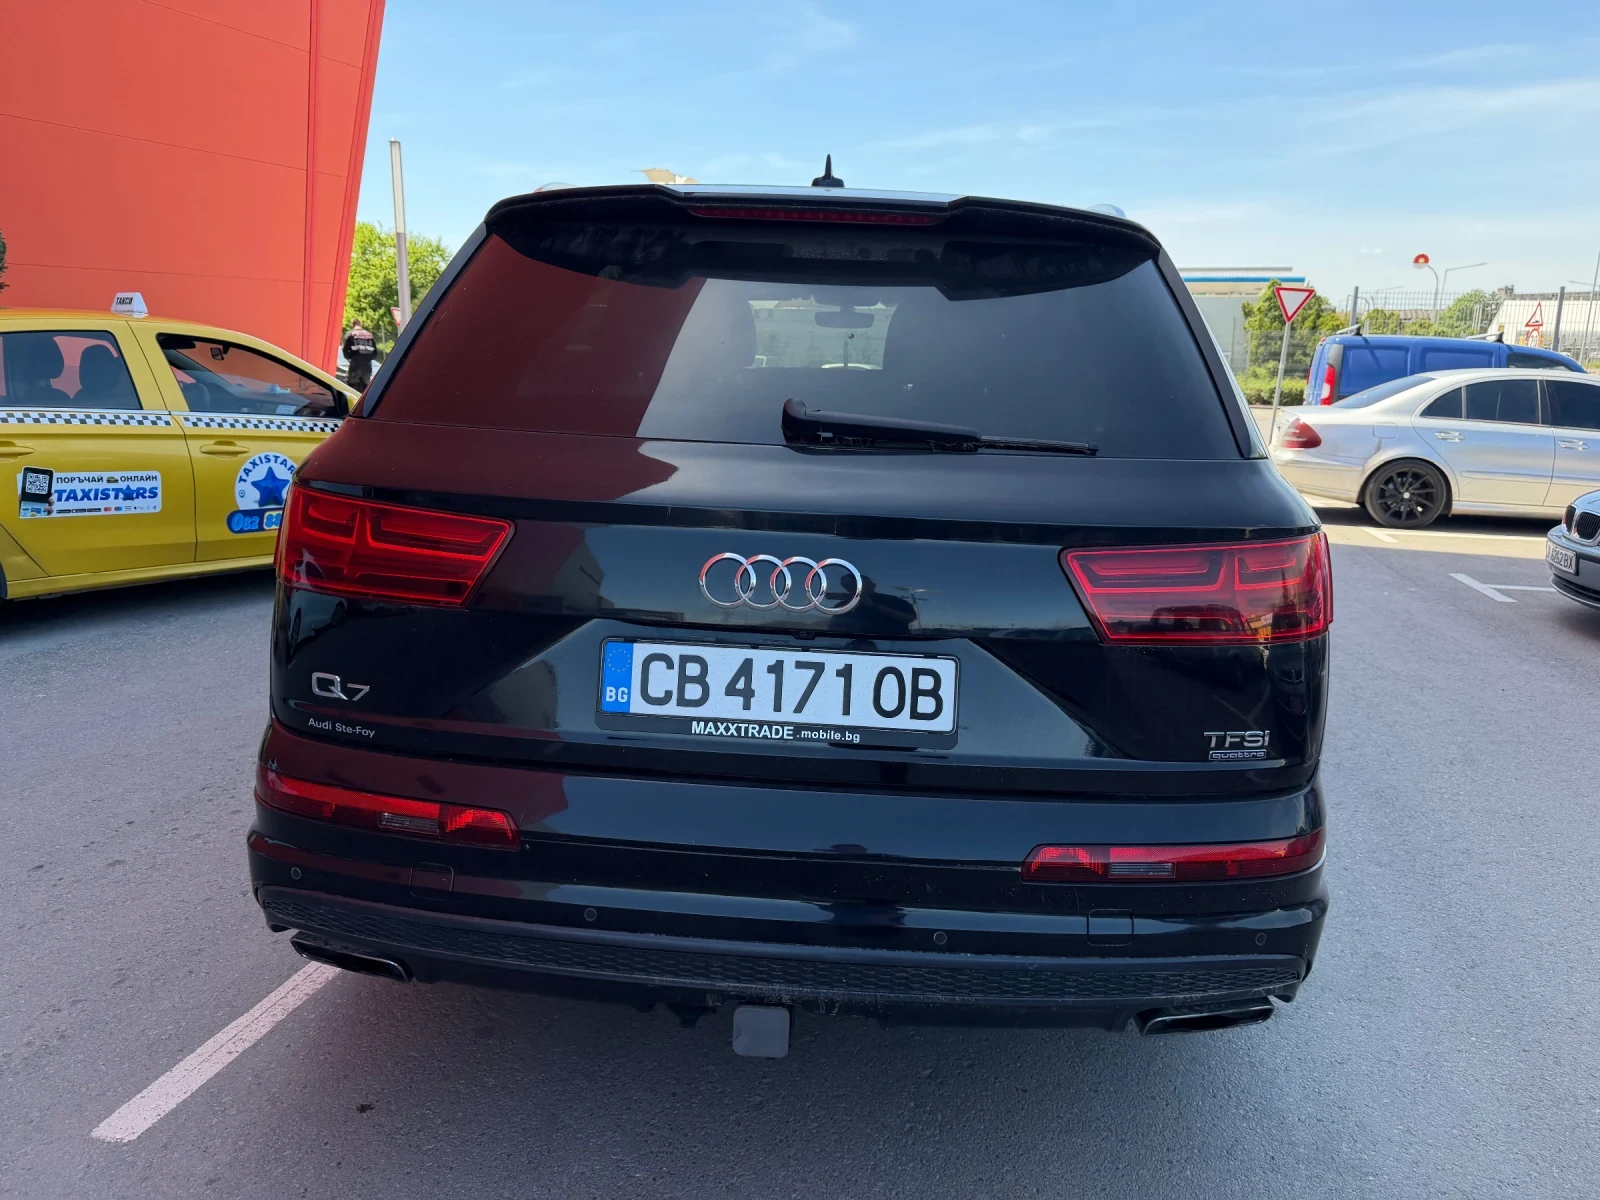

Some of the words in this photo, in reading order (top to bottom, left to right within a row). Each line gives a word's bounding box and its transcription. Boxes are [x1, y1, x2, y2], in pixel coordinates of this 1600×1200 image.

[56, 475, 104, 484] ПОРЪЧАЙ
[120, 474, 158, 483] ОНЛАЙН
[238, 454, 297, 484] TAXISTAR
[311, 672, 370, 701] Q7
[605, 686, 629, 703] BG
[640, 653, 710, 708] CB
[724, 659, 851, 716] 4171
[873, 666, 944, 721] OB
[308, 718, 332, 730] Audi
[335, 723, 375, 738] Ste-Foy
[691, 720, 794, 740] MAXXTRADE
[1212, 752, 1264, 760] quattro
